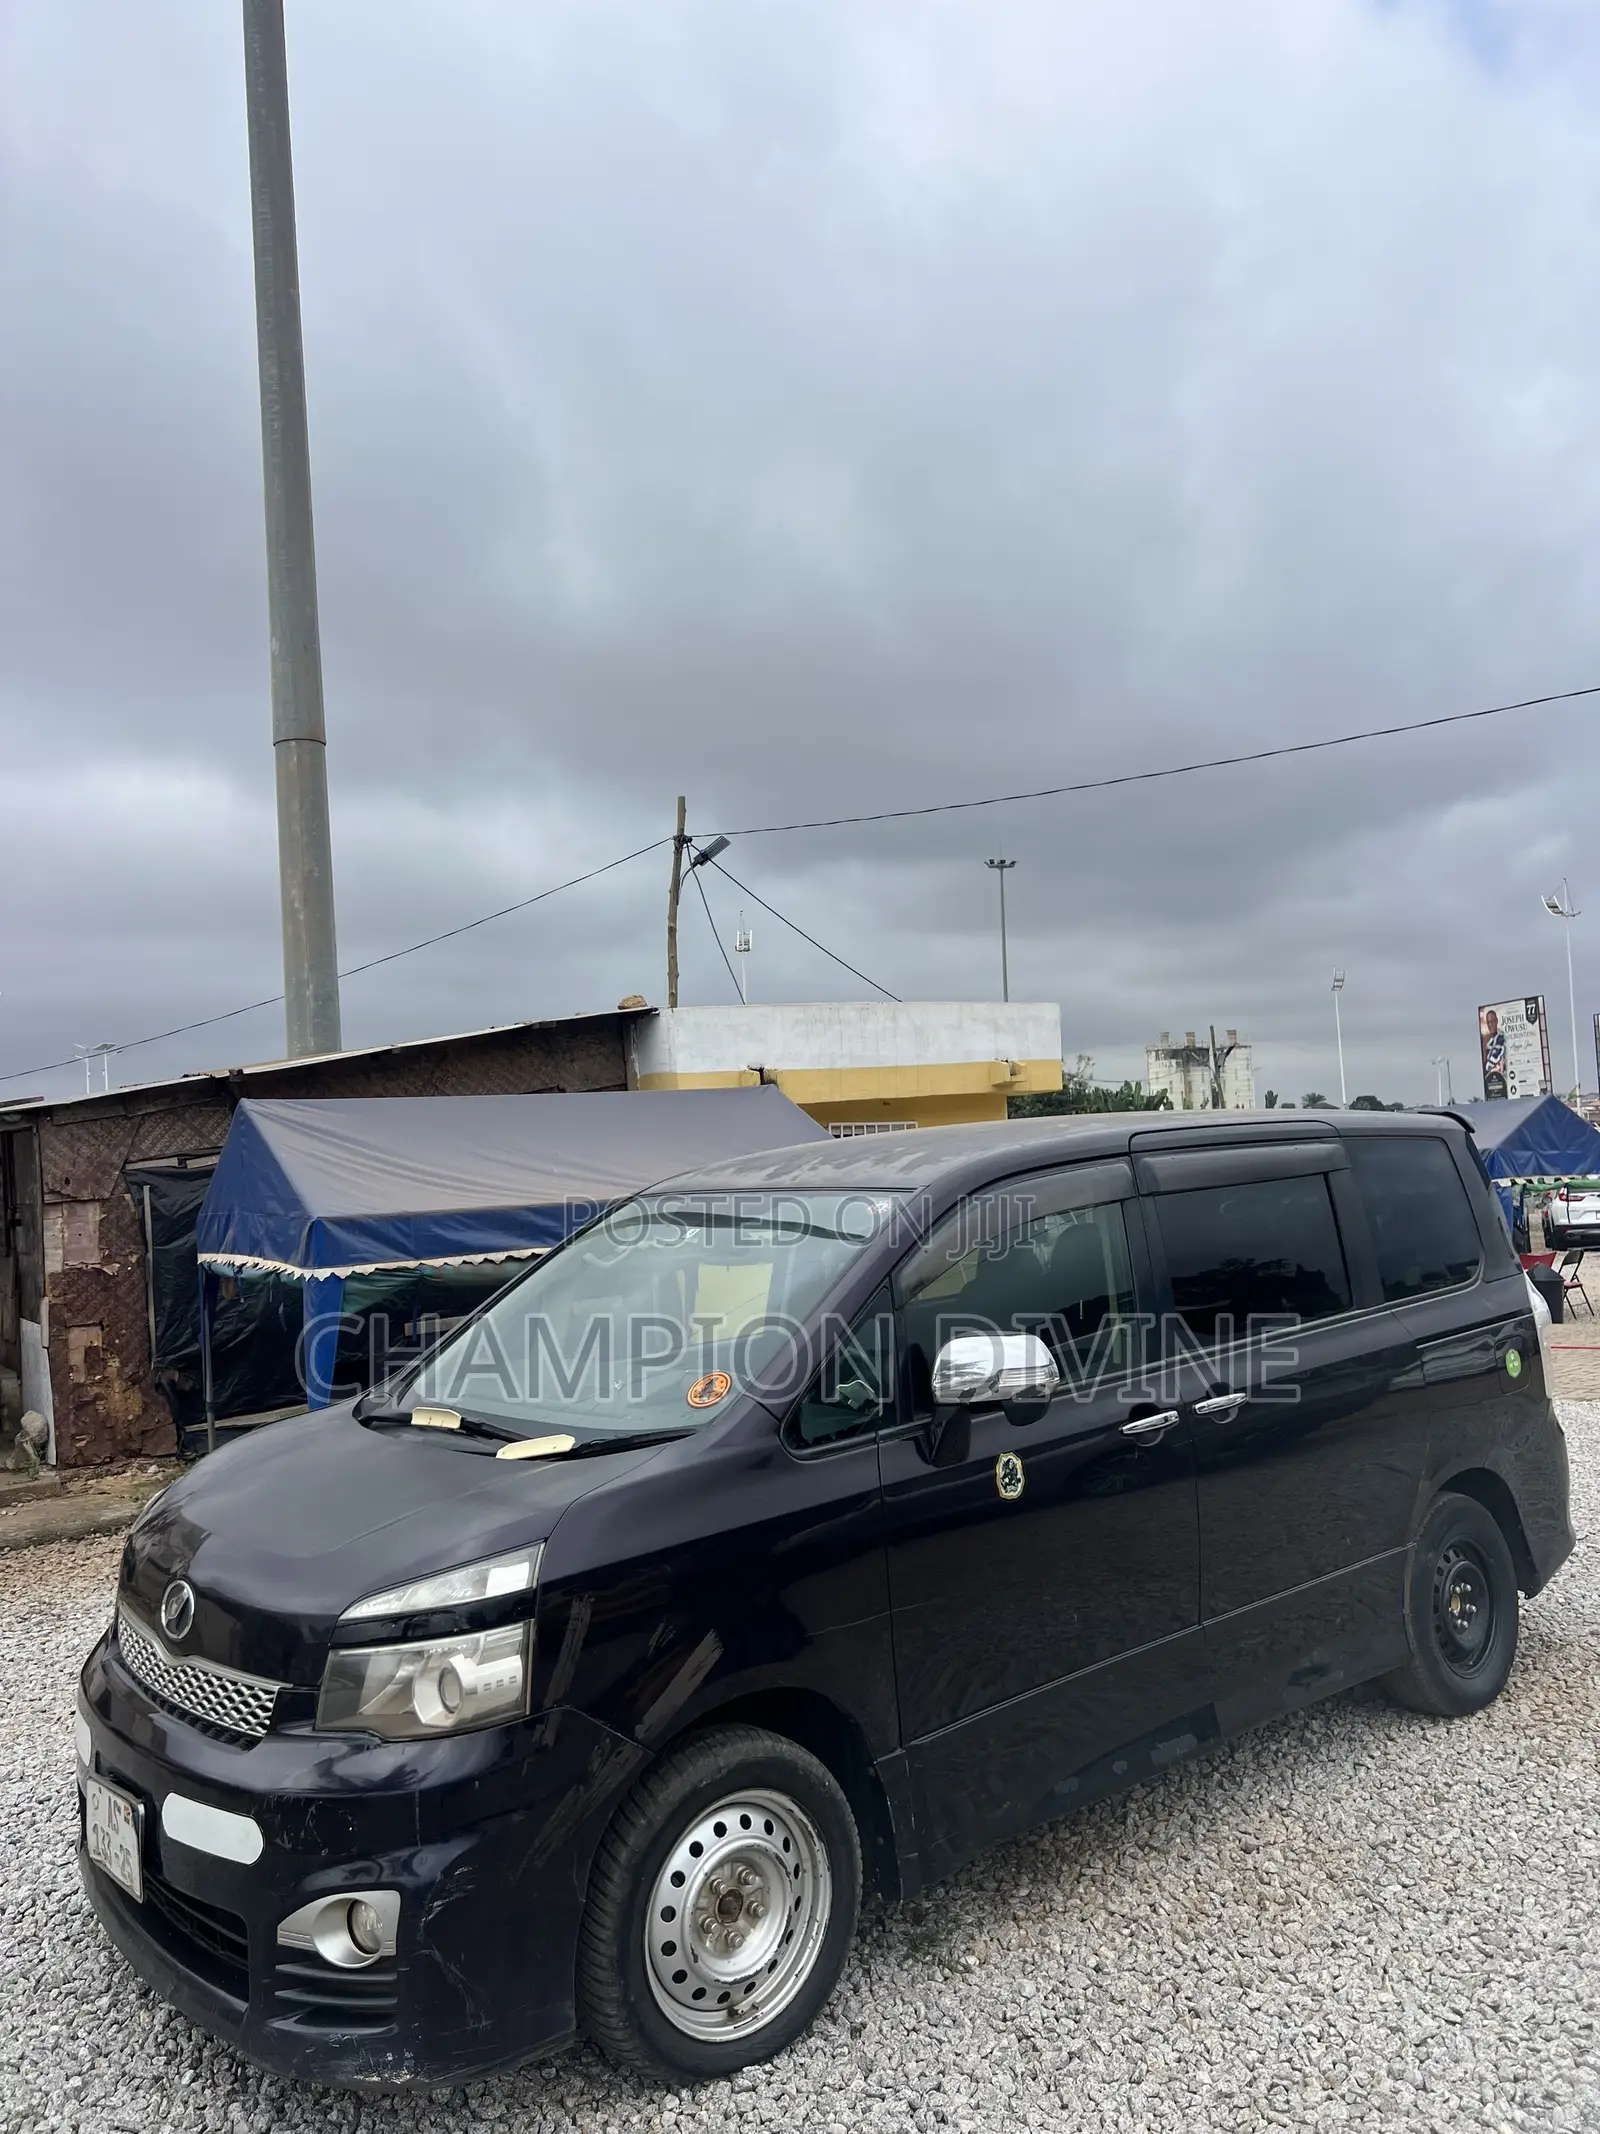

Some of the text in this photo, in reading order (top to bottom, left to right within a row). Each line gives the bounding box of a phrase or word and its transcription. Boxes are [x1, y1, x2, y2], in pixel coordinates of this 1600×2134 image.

[1526, 1003, 1536, 1015] 77
[1501, 1014, 1525, 1026] JOSEPH
[1504, 1023, 1528, 1033] OWUSU
[108, 1795, 121, 1835] AS
